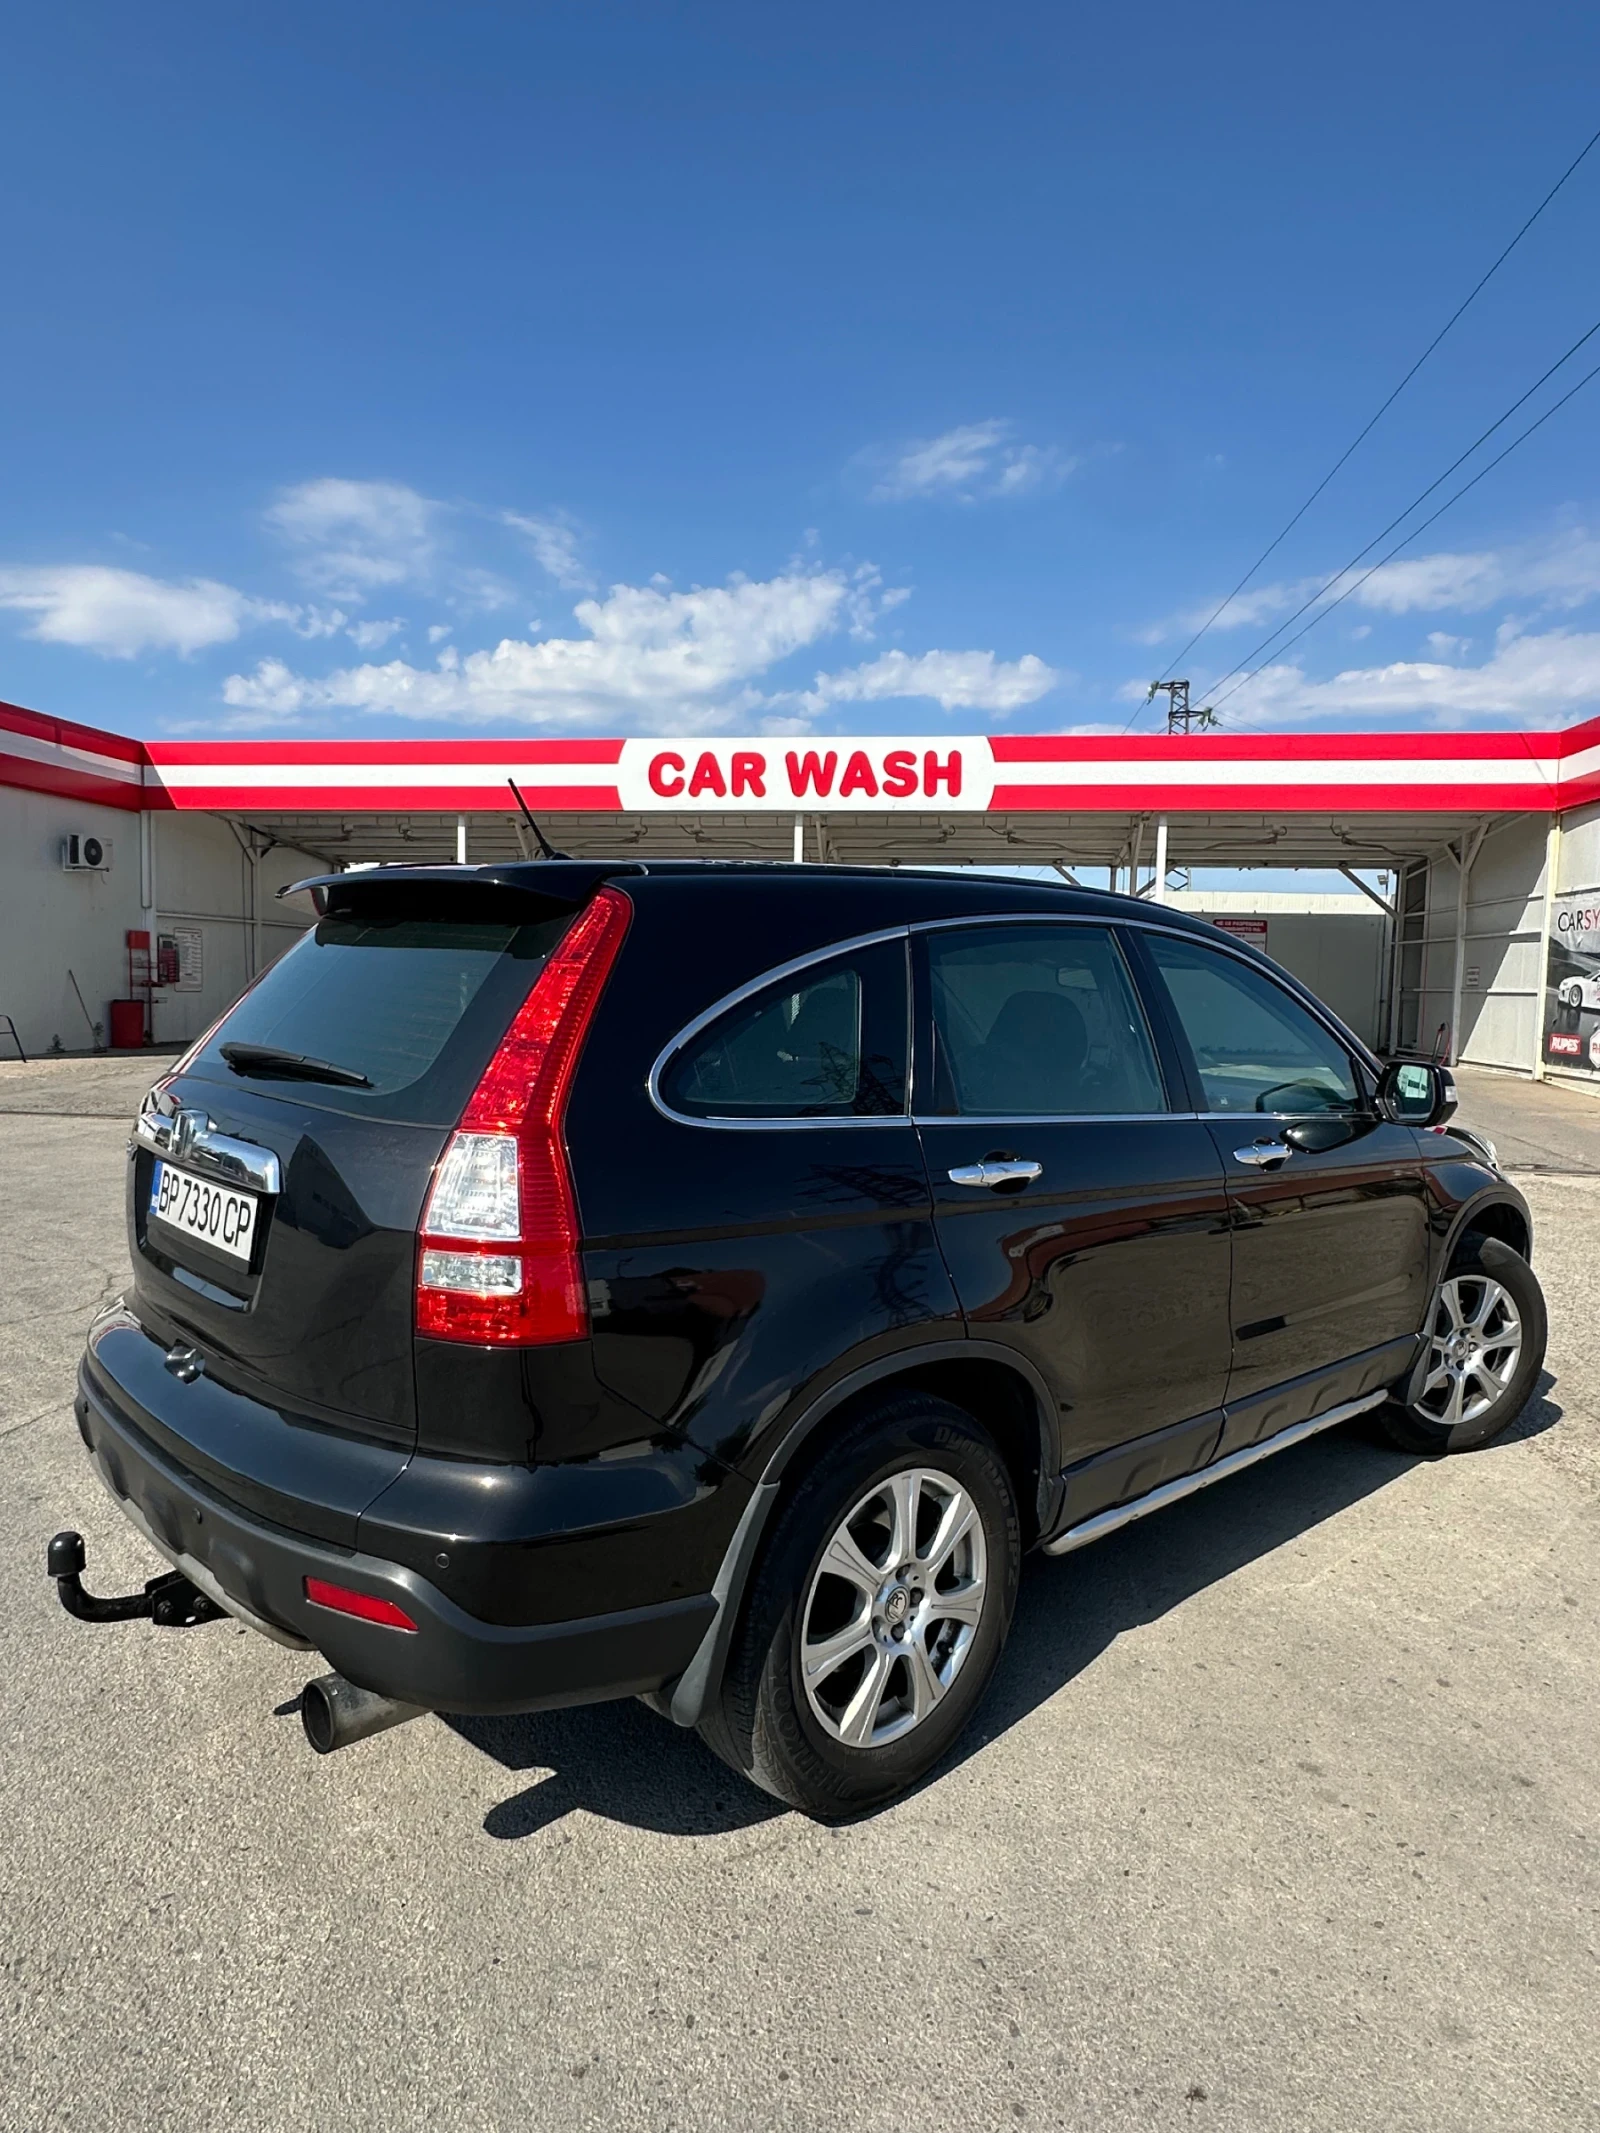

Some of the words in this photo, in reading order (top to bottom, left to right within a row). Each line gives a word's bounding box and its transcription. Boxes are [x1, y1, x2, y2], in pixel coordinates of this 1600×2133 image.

[648, 751, 766, 798] CAR
[785, 750, 962, 798] WASH
[1551, 1036, 1580, 1053] RUPES
